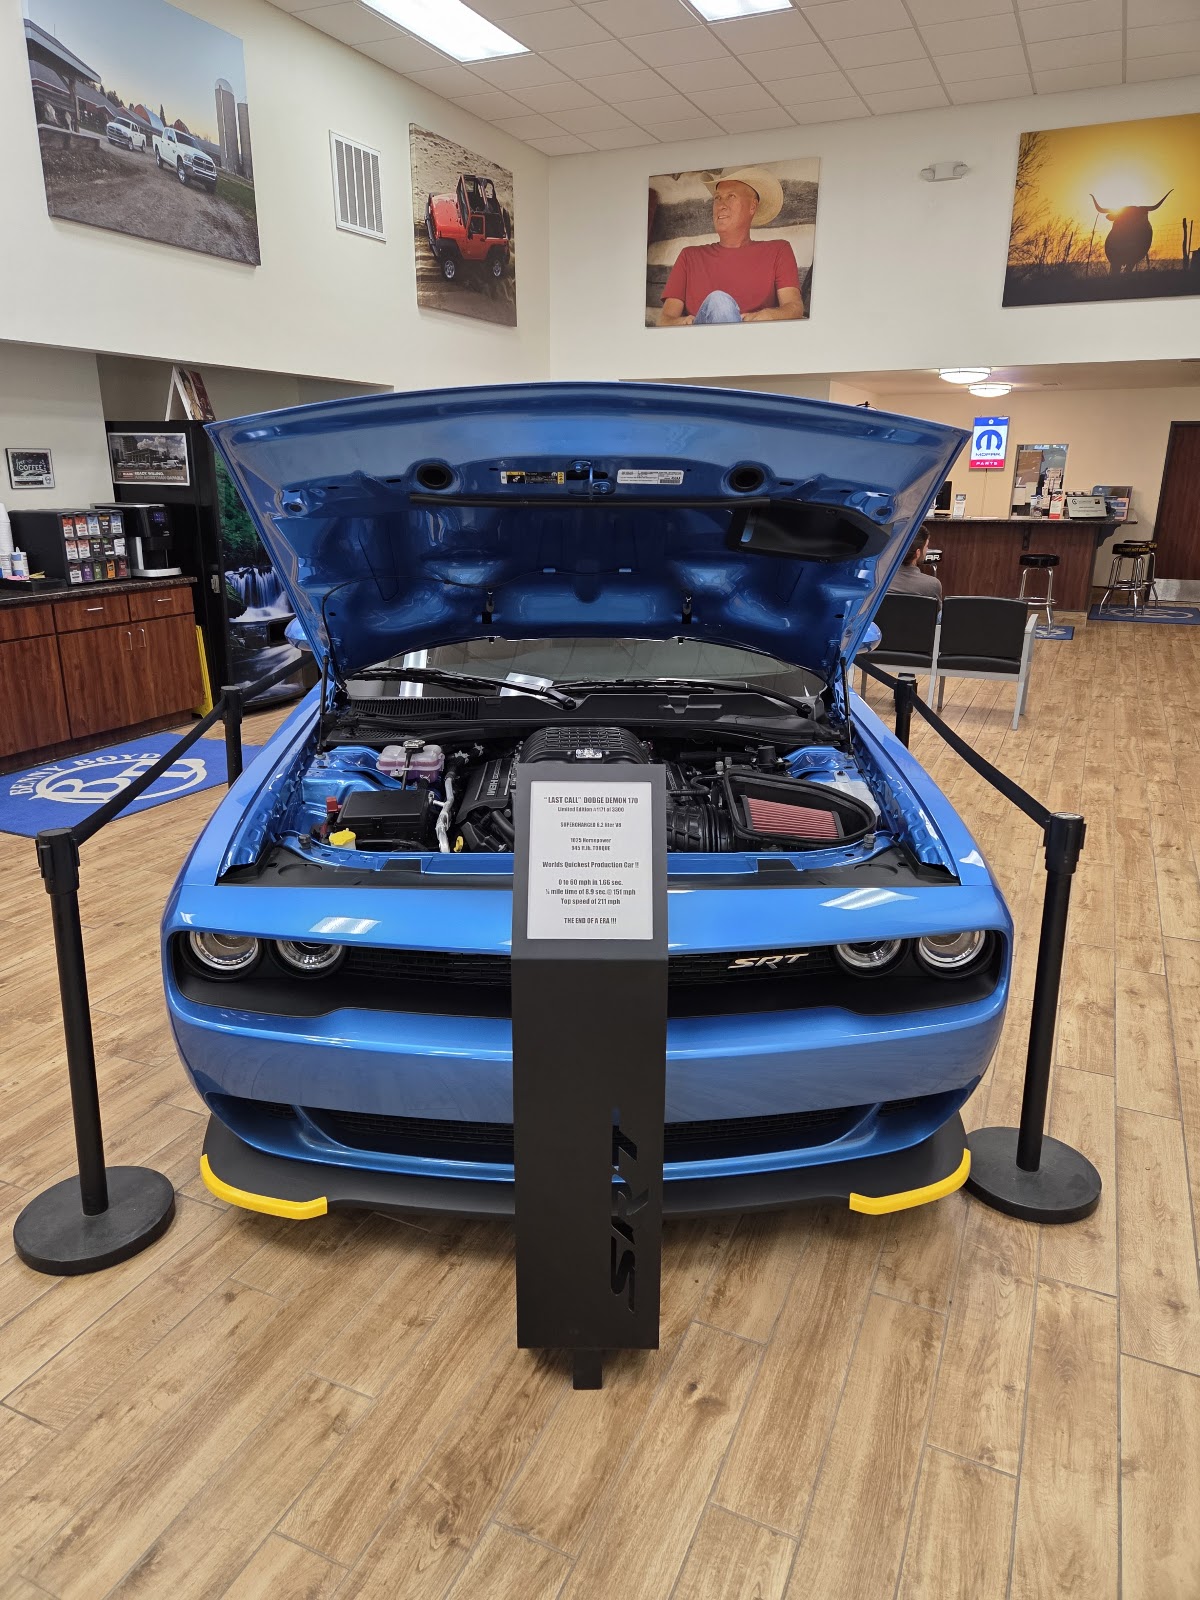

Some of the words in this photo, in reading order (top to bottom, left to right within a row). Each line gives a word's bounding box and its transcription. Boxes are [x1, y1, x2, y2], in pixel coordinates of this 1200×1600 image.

[74, 753, 162, 766] BOYD
[9, 765, 65, 796] BENNY
[727, 952, 809, 970] SRT
[610, 1108, 650, 1315] SRT
